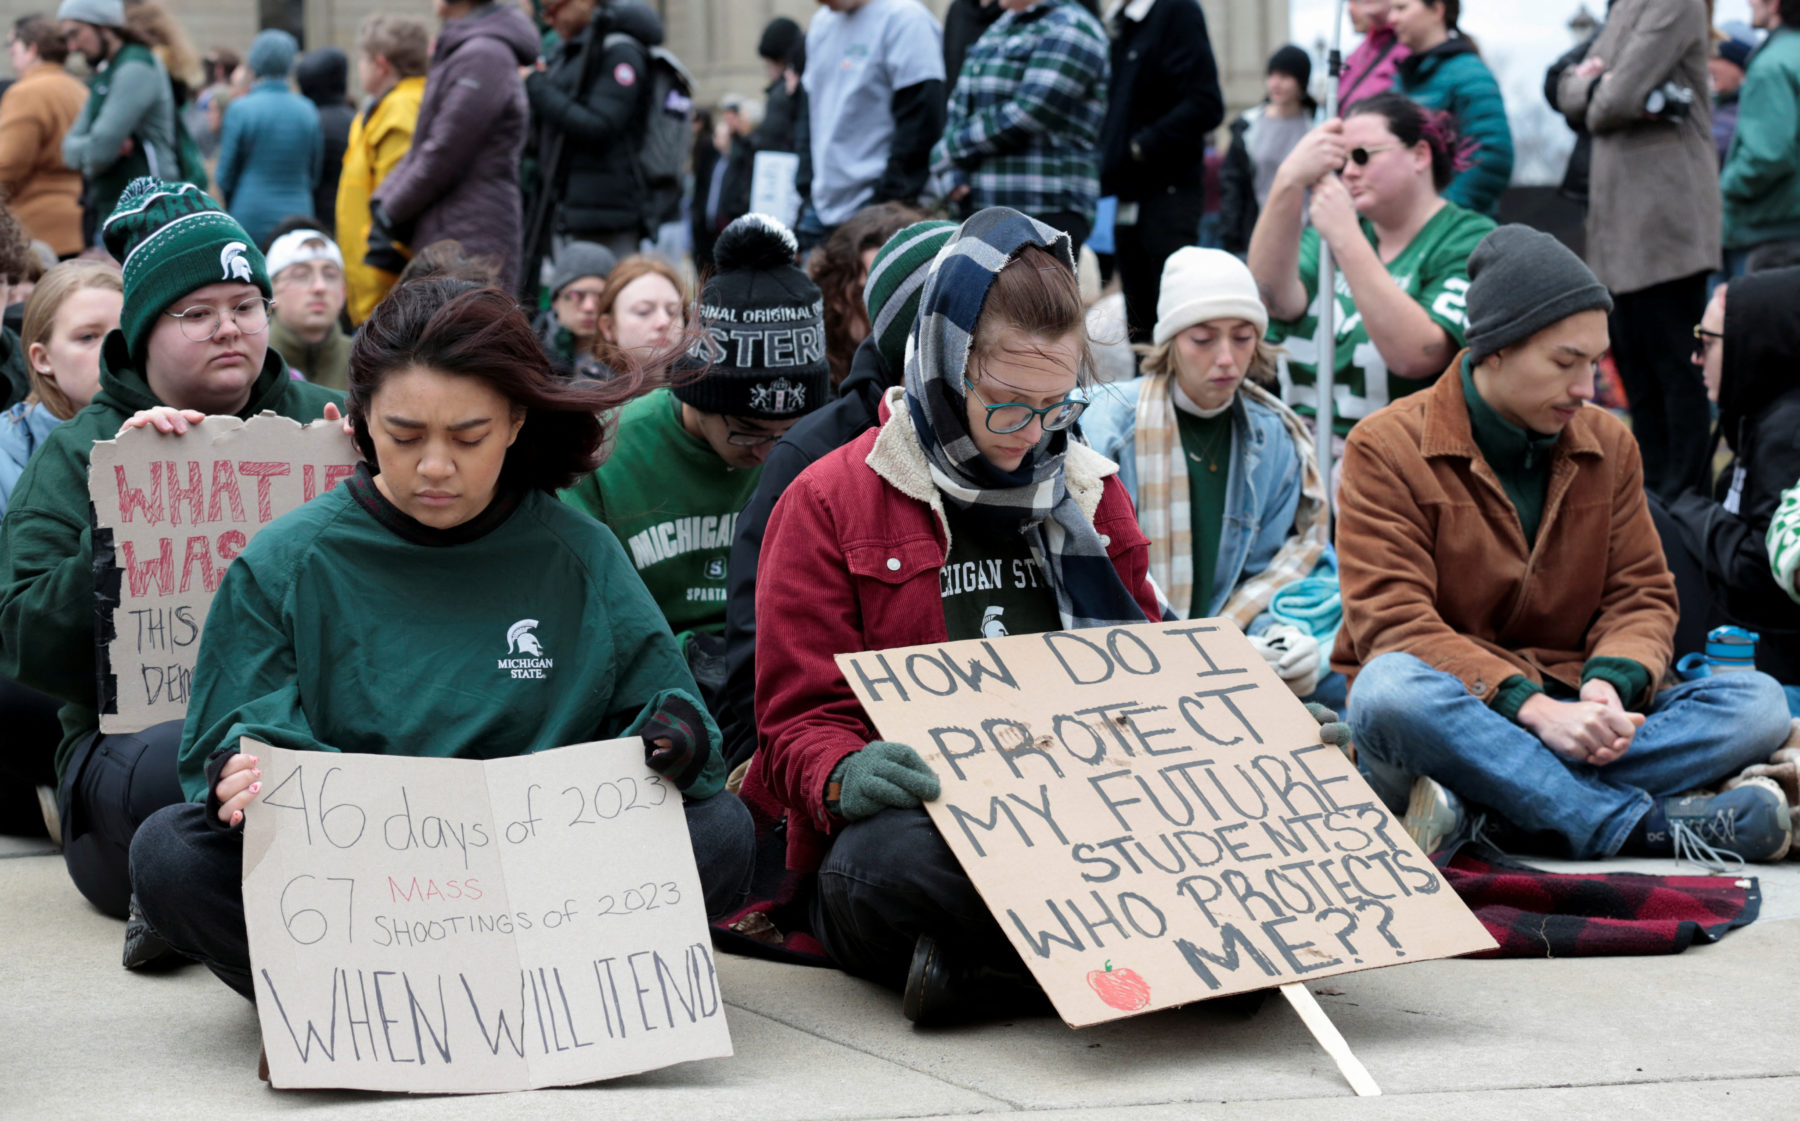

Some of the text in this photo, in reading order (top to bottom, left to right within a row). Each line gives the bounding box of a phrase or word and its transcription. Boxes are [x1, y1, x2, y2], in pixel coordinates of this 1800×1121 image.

[743, 306, 812, 323] ORIGINAL
[114, 460, 291, 527] WHAT
[122, 529, 247, 598] WAS
[709, 560, 722, 576] S
[129, 605, 199, 655] THIS
[497, 658, 554, 670] MICHIGAN
[850, 626, 1248, 702] HOW DO I
[511, 669, 543, 679] STATE
[928, 683, 1264, 781] PROTECT
[262, 765, 667, 870] 46 days of 2023
[946, 744, 1375, 857] MY FUTURE
[1072, 806, 1399, 883] STUDENTS?
[281, 874, 483, 945] 67 MASS
[373, 882, 681, 947] SHOOTINGS of 2023
[1006, 850, 1440, 959] WHO PROTECTS
[1173, 899, 1406, 990] ME??
[261, 943, 718, 1065] WHEN WILL IT END
